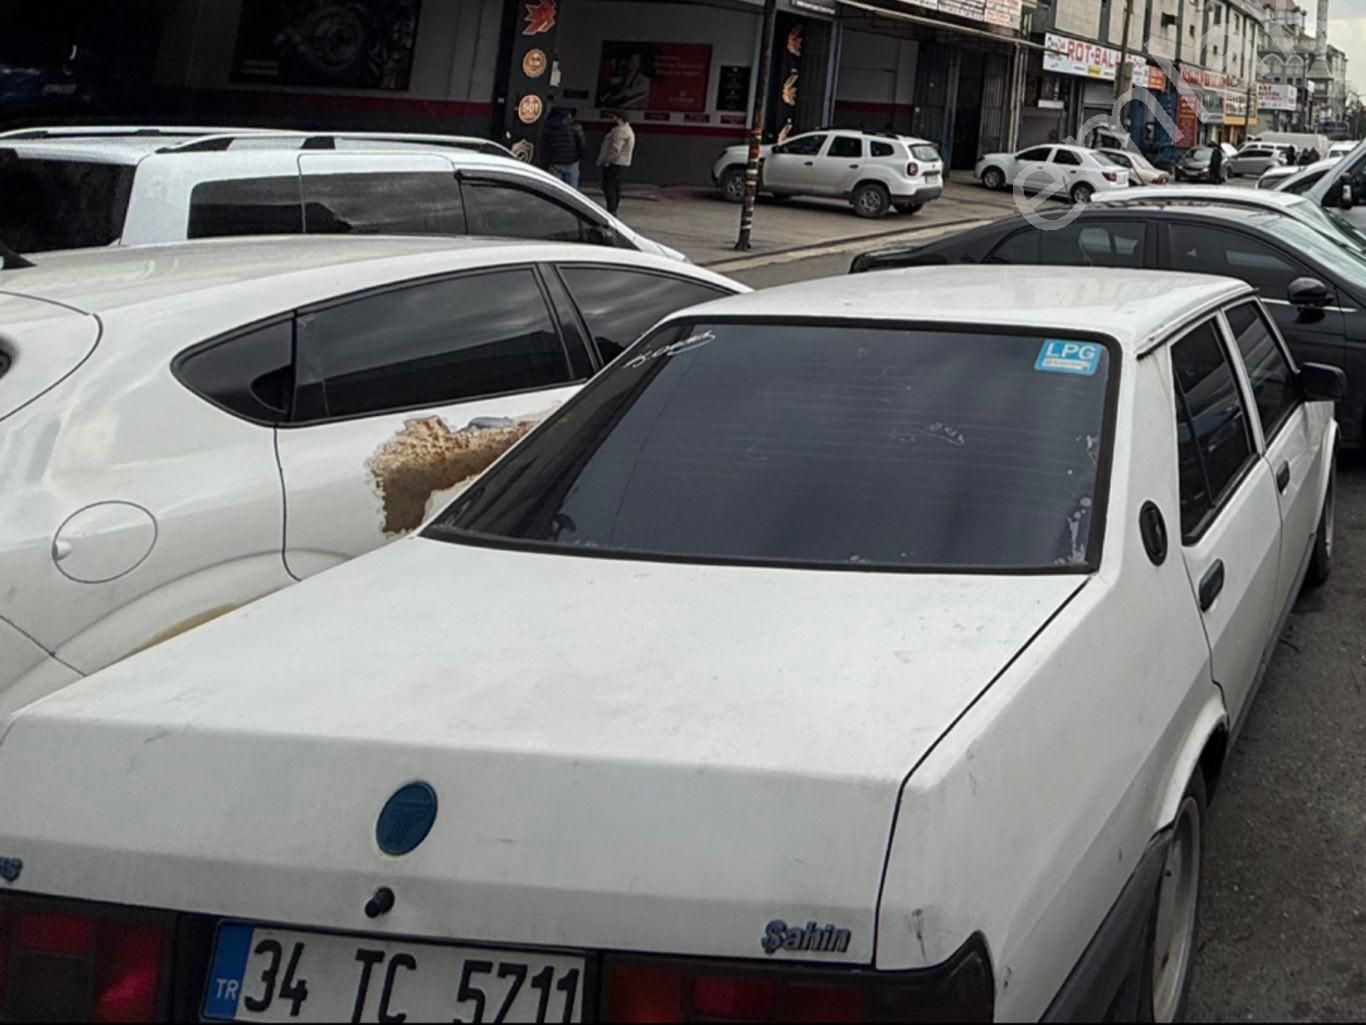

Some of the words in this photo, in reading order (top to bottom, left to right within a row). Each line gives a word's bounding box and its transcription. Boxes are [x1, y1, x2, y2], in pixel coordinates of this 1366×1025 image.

[1046, 342, 1097, 360] LPG
[761, 919, 851, 955] Şahin
[216, 978, 238, 1000] TR
[244, 939, 309, 1016] 34
[352, 948, 417, 1024] TC
[454, 959, 581, 1024] 5711
